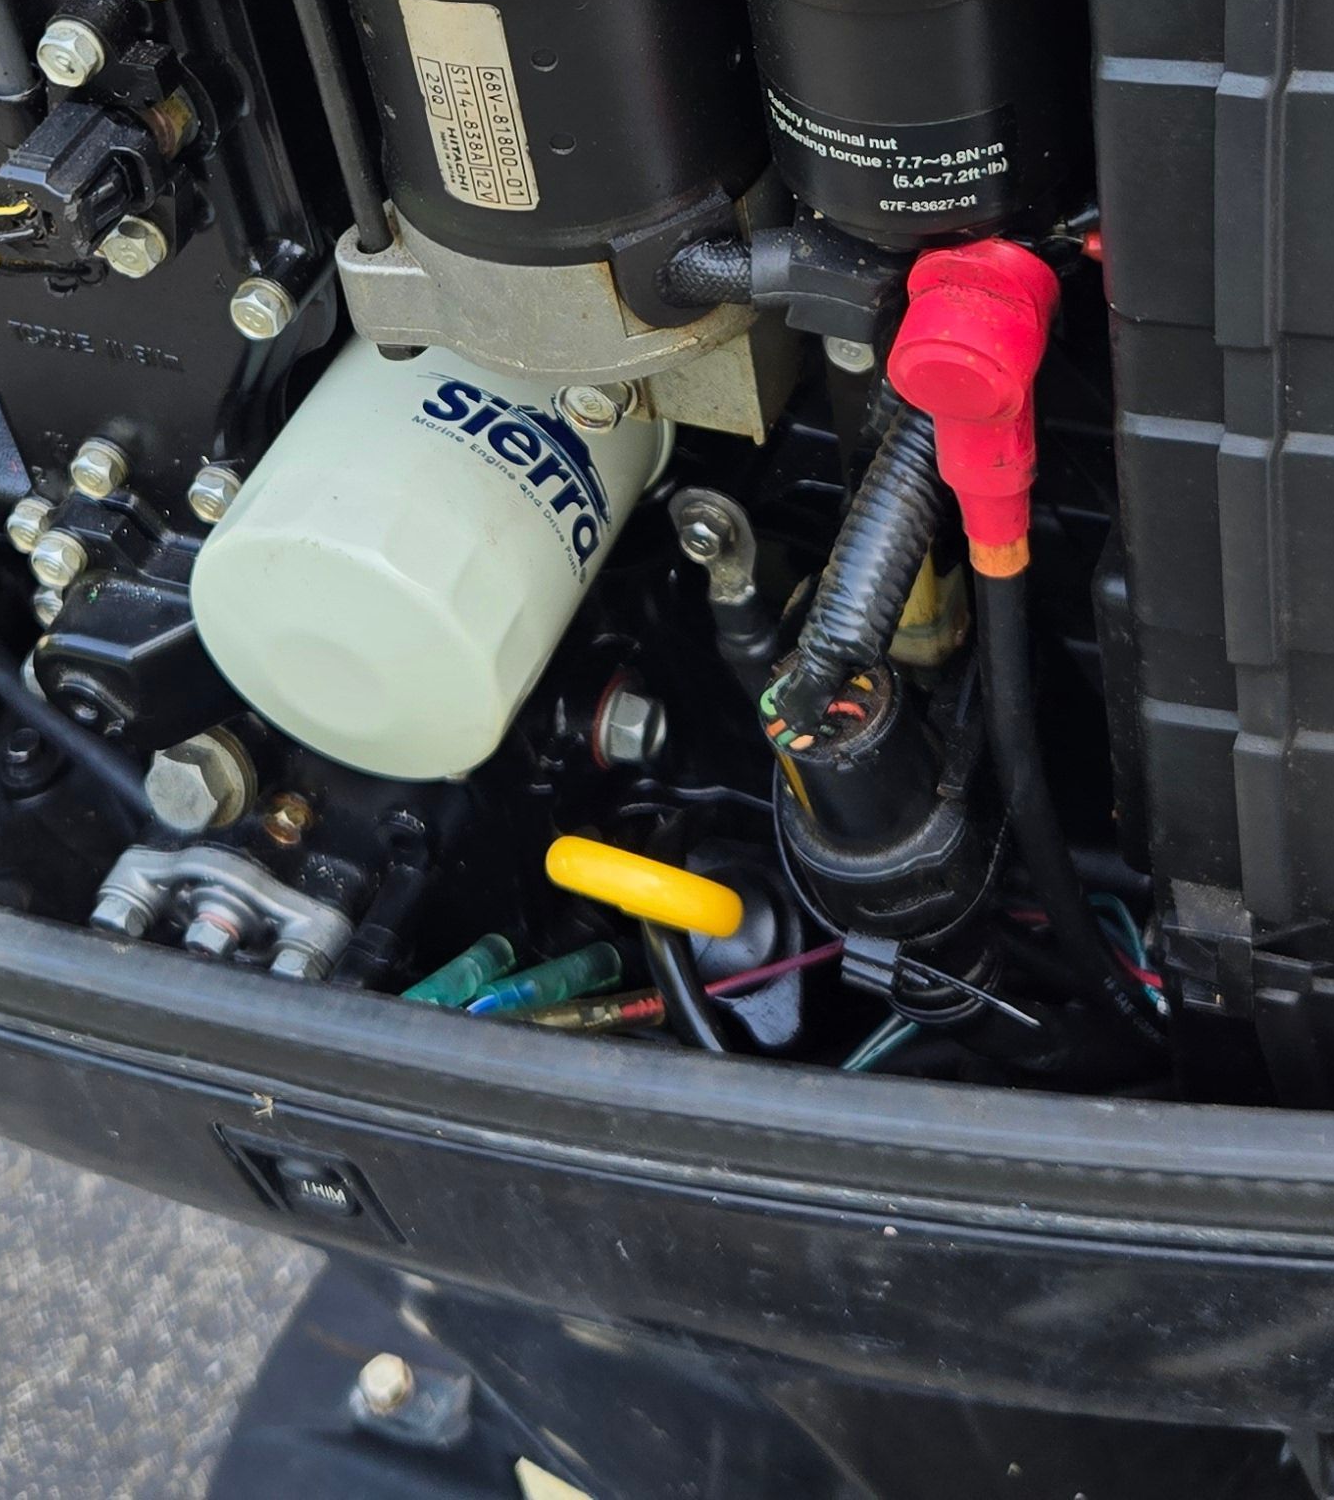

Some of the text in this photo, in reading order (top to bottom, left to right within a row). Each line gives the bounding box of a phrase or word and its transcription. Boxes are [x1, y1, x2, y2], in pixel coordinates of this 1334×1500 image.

[447, 127, 469, 192] HITACHI
[451, 67, 495, 202] S114-838A 12V
[483, 71, 525, 197] 68V-81800-01
[770, 106, 827, 157] Tightening
[829, 146, 882, 168] torque
[805, 118, 865, 147] terminal
[869, 138, 898, 150] nut
[879, 194, 977, 212] 67F-83627-01
[411, 415, 465, 443] Marine
[469, 443, 516, 481] Engine
[519, 482, 542, 508] and
[543, 508, 565, 544] Drive
